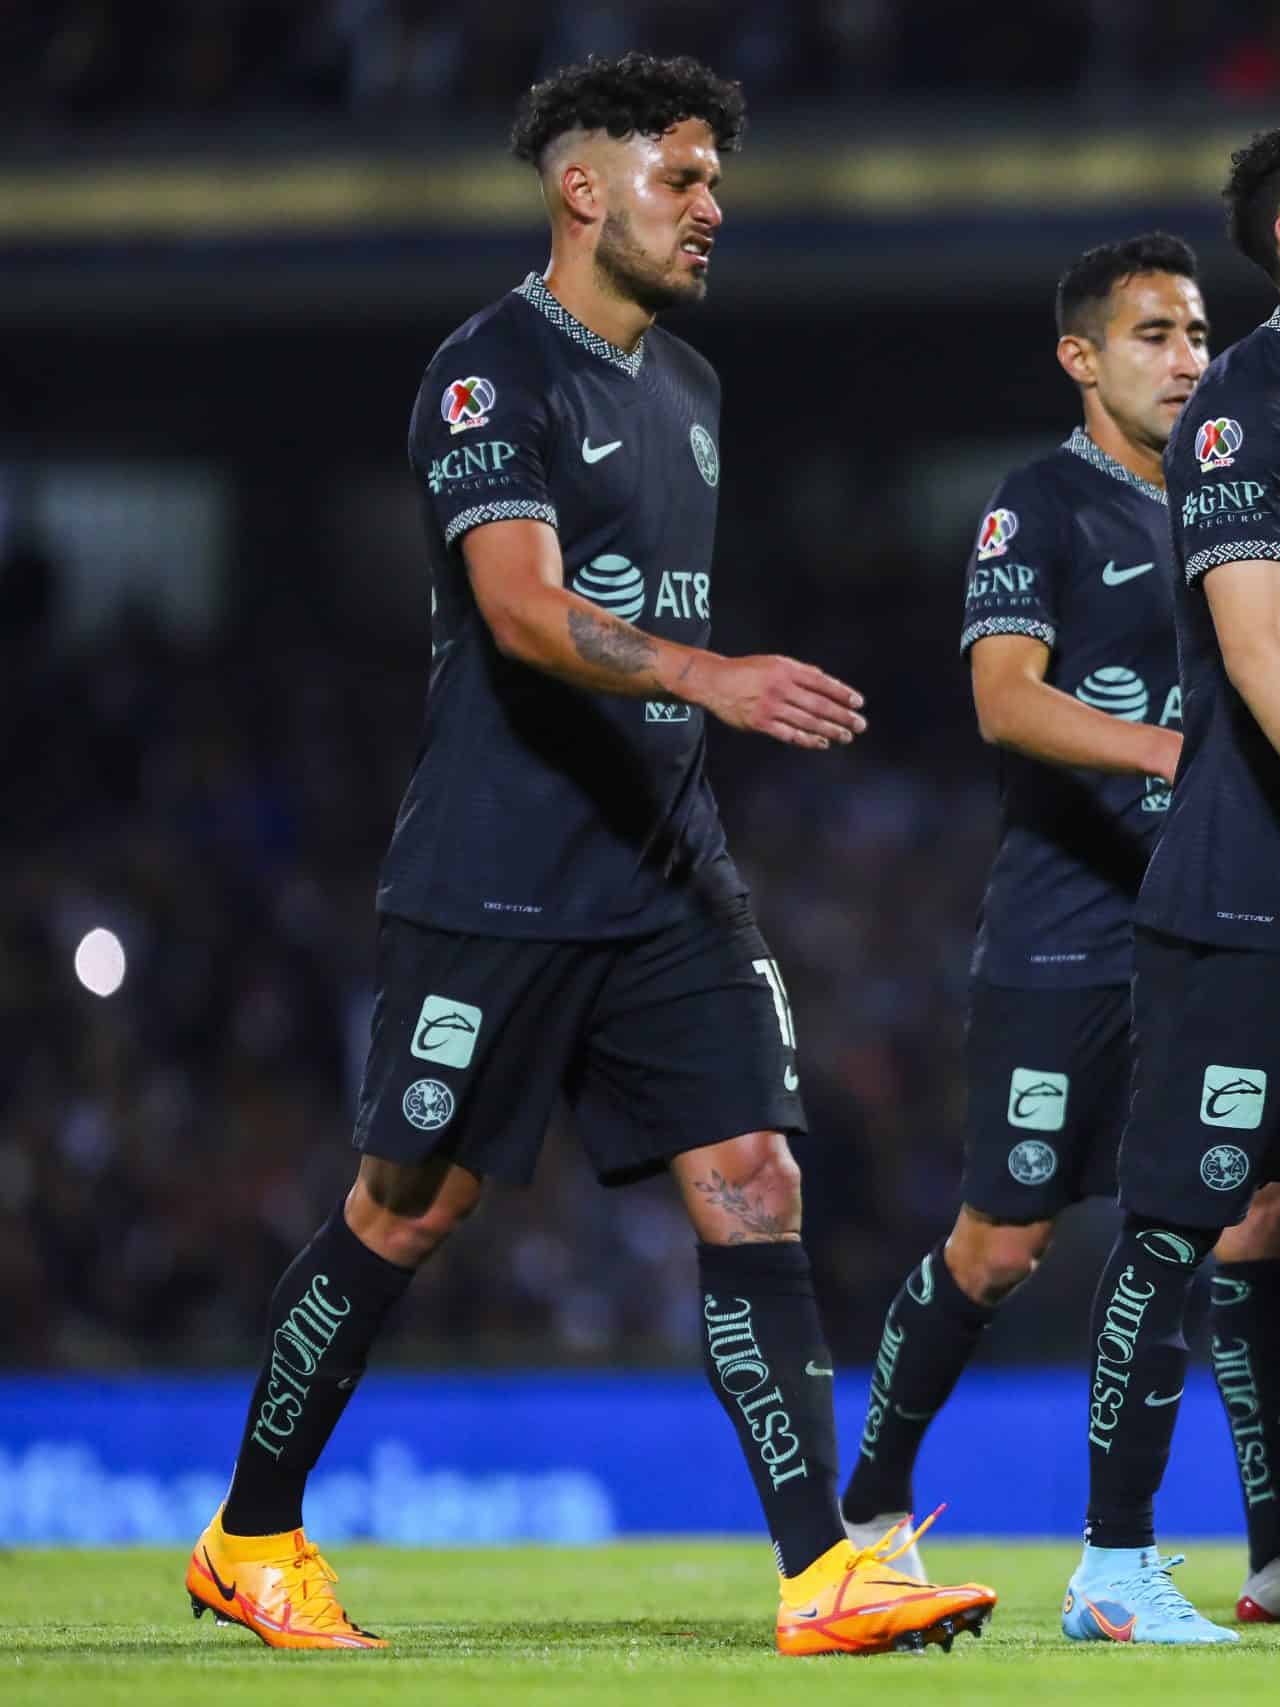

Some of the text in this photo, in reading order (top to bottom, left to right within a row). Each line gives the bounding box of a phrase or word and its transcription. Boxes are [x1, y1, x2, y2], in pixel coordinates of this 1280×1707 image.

[441, 440, 516, 479] GNP
[1199, 480, 1265, 514] GNP
[1199, 512, 1268, 529] SEGURO
[654, 570, 711, 619] AT&
[973, 563, 1035, 598] GNP
